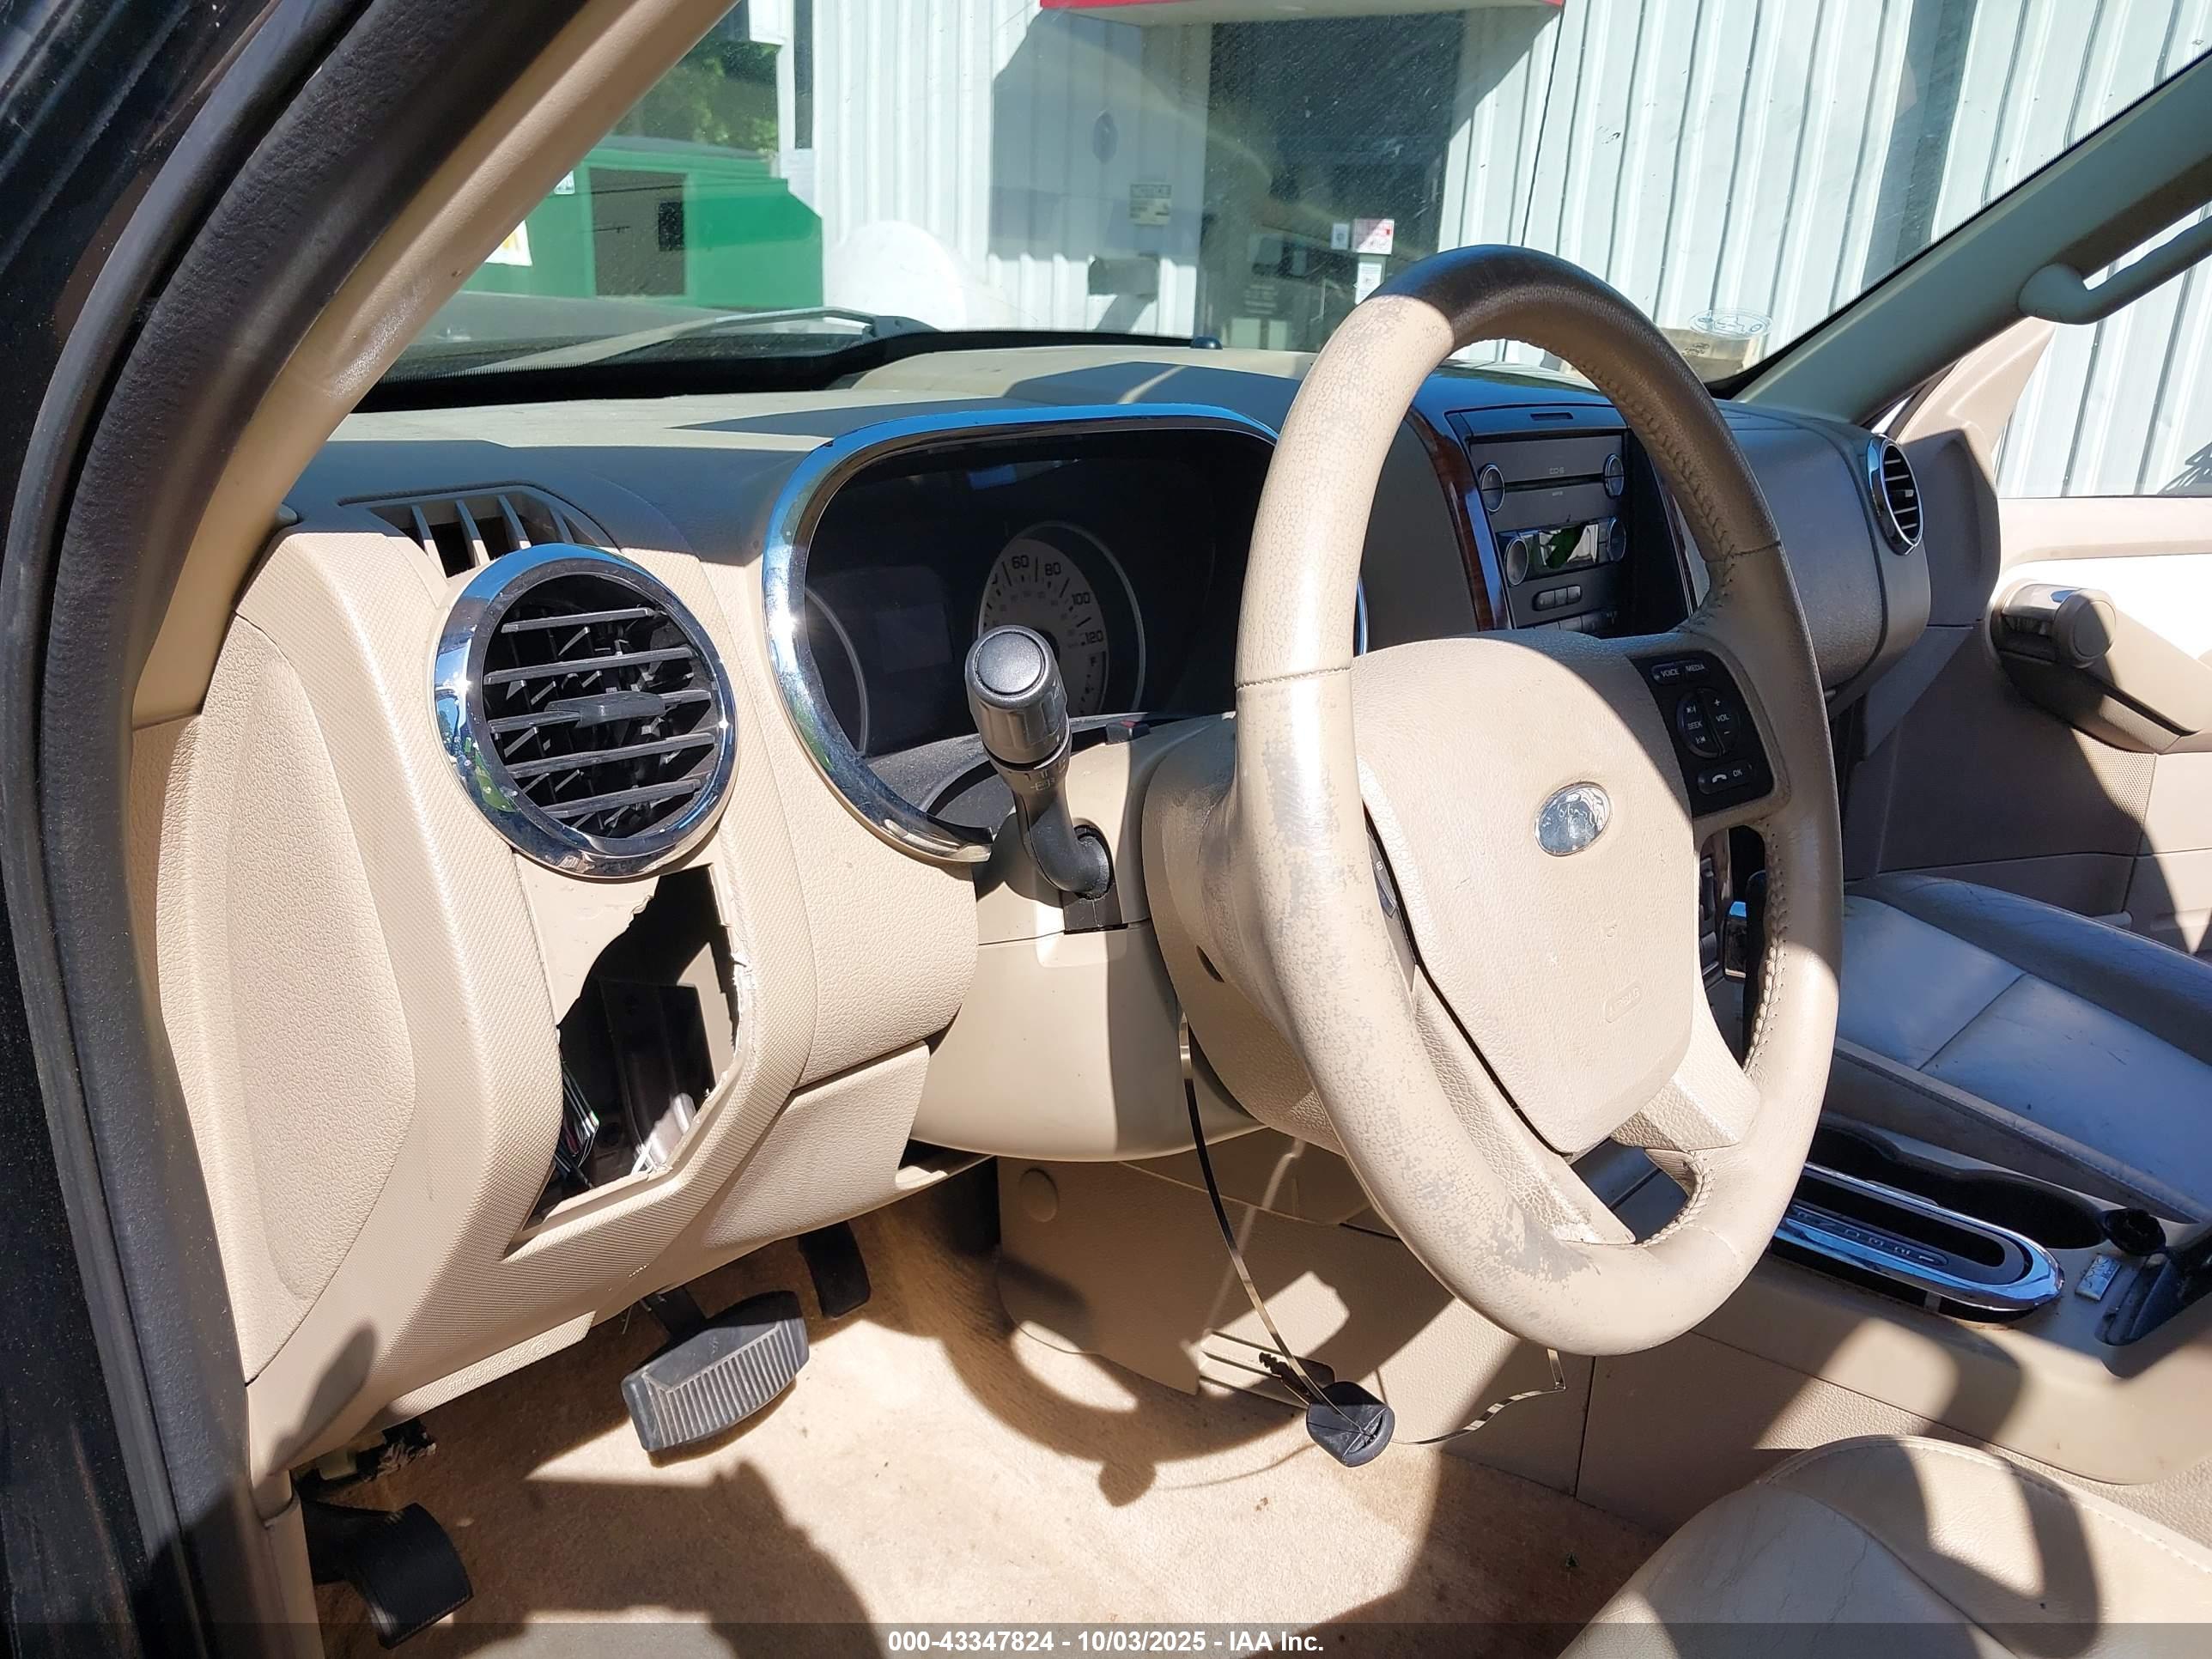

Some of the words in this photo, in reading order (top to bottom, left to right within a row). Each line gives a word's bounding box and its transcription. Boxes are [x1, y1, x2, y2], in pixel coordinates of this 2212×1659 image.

[1012, 555, 1030, 568] 60
[1044, 562, 1062, 576] 80
[1072, 592, 1091, 605] 100
[1085, 629, 1103, 643] 120
[1661, 668, 1680, 678] VOICE
[1716, 714, 1729, 722] VOL
[1687, 720, 1703, 730] SEEK
